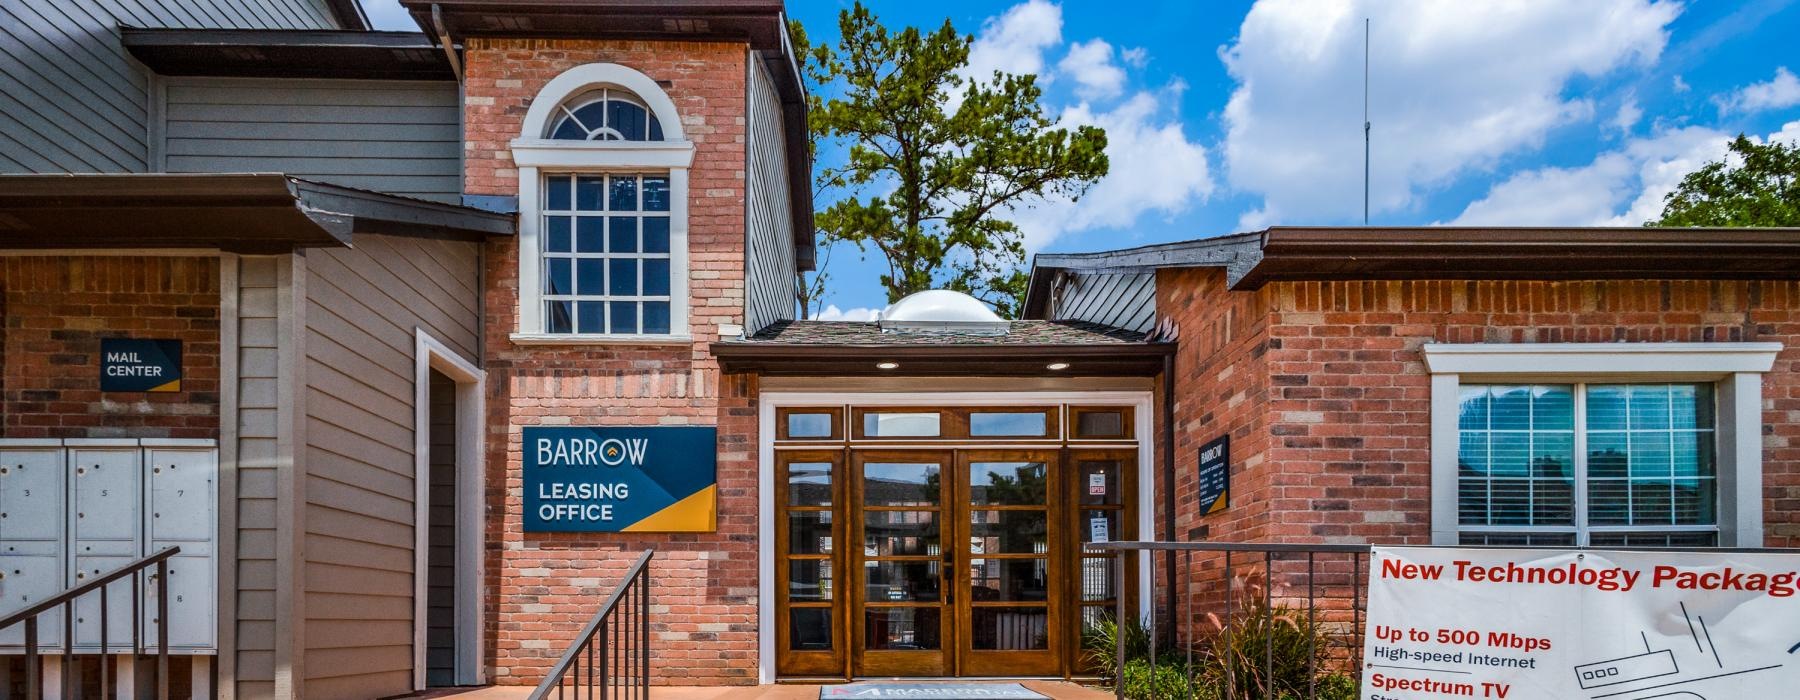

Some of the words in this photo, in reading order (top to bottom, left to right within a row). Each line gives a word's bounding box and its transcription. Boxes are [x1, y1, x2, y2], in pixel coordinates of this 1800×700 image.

[107, 352, 142, 363] MAIL
[107, 365, 162, 377] CENTER
[537, 438, 648, 465] BARROW
[102, 489, 108, 497] 5
[177, 489, 184, 497] 7
[539, 483, 629, 499] LEASING
[539, 504, 613, 521] OFFICE
[1382, 559, 1443, 580] New
[1453, 560, 1641, 592] Technology
[1653, 565, 1800, 598] Packag
[1376, 625, 1402, 643] Up
[1409, 627, 1430, 643] to
[1436, 629, 1480, 646] 500
[1488, 632, 1552, 653] Mbps
[1374, 646, 1462, 663] High-speed
[1469, 653, 1536, 669] Internet
[1371, 673, 1474, 696] Spectrum
[1481, 682, 1511, 699] TV
